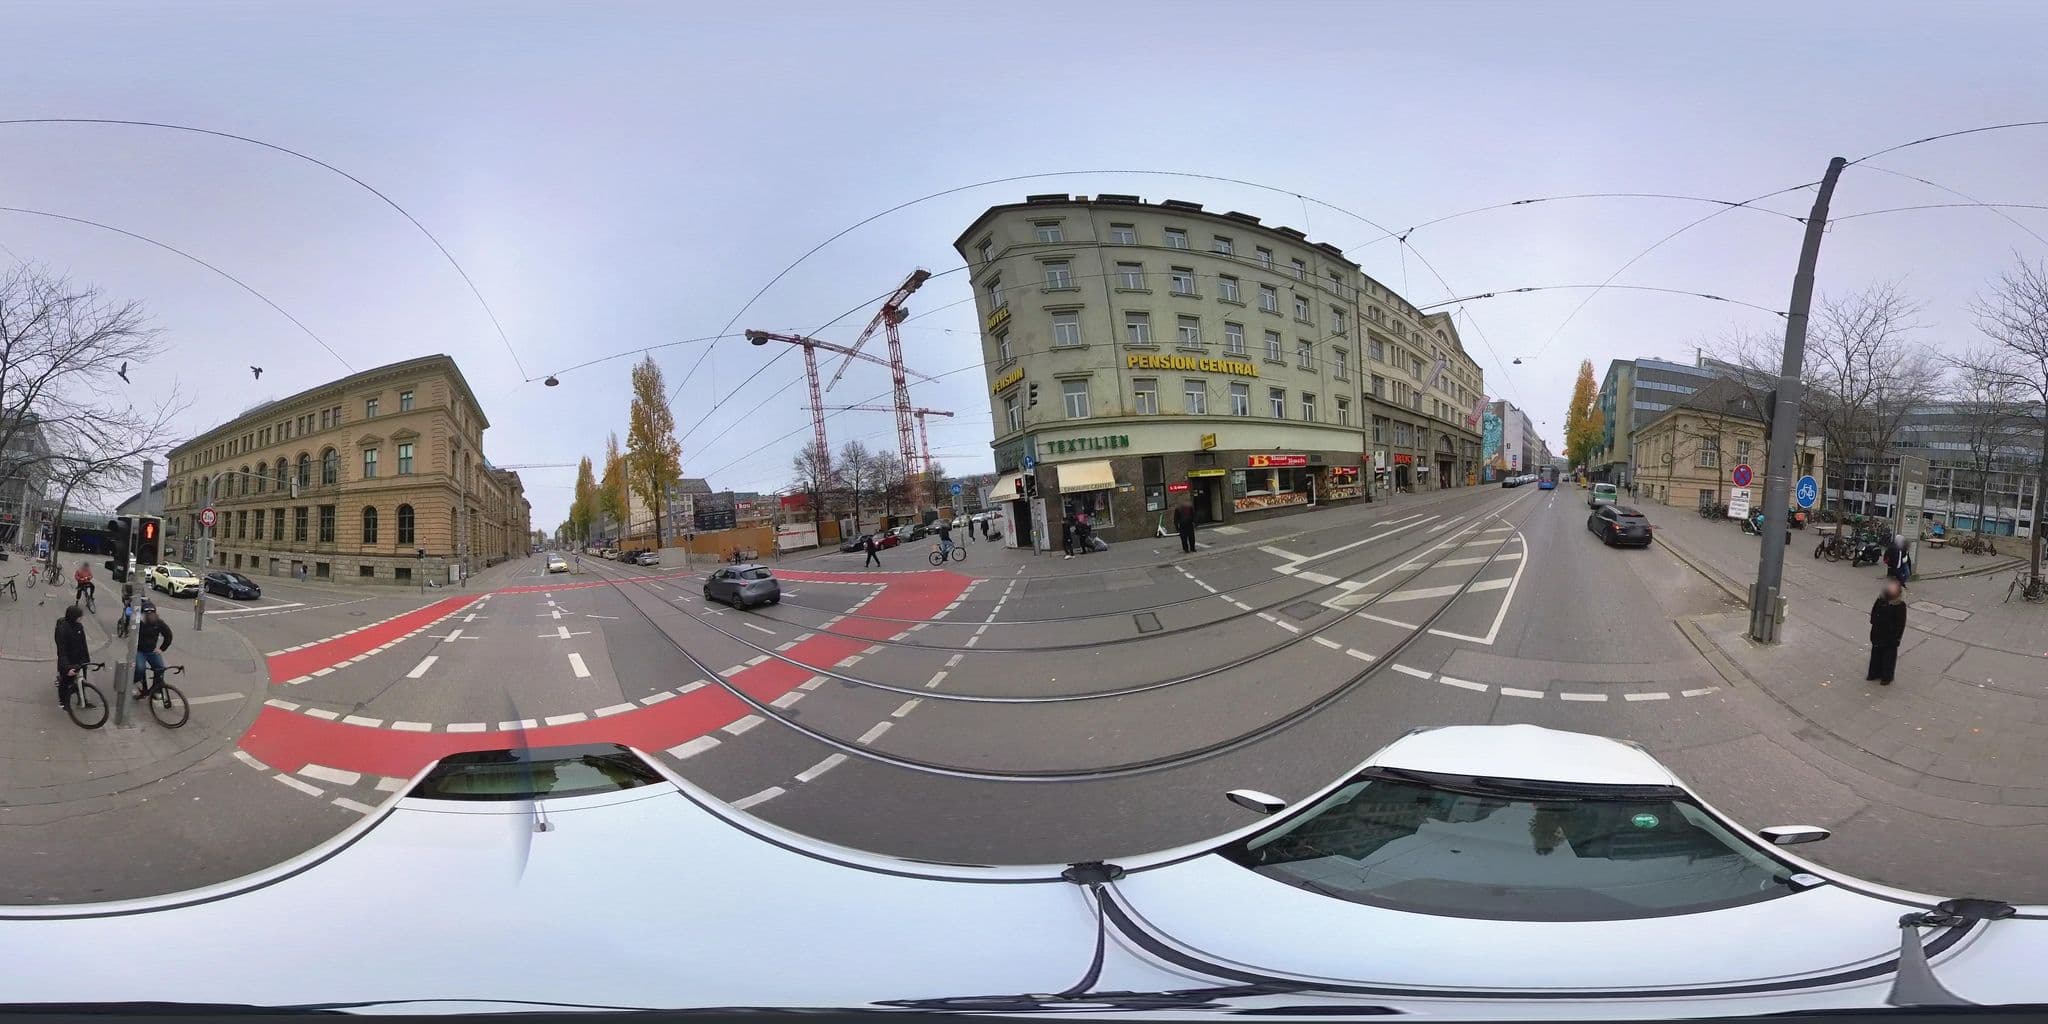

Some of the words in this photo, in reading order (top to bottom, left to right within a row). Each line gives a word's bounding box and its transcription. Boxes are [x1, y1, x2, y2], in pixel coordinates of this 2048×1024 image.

[1127, 353, 1195, 370] PENSION
[1199, 358, 1259, 377] CENTRAL
[992, 367, 1025, 394] PENSION
[1047, 434, 1129, 454] TEXTILIEN
